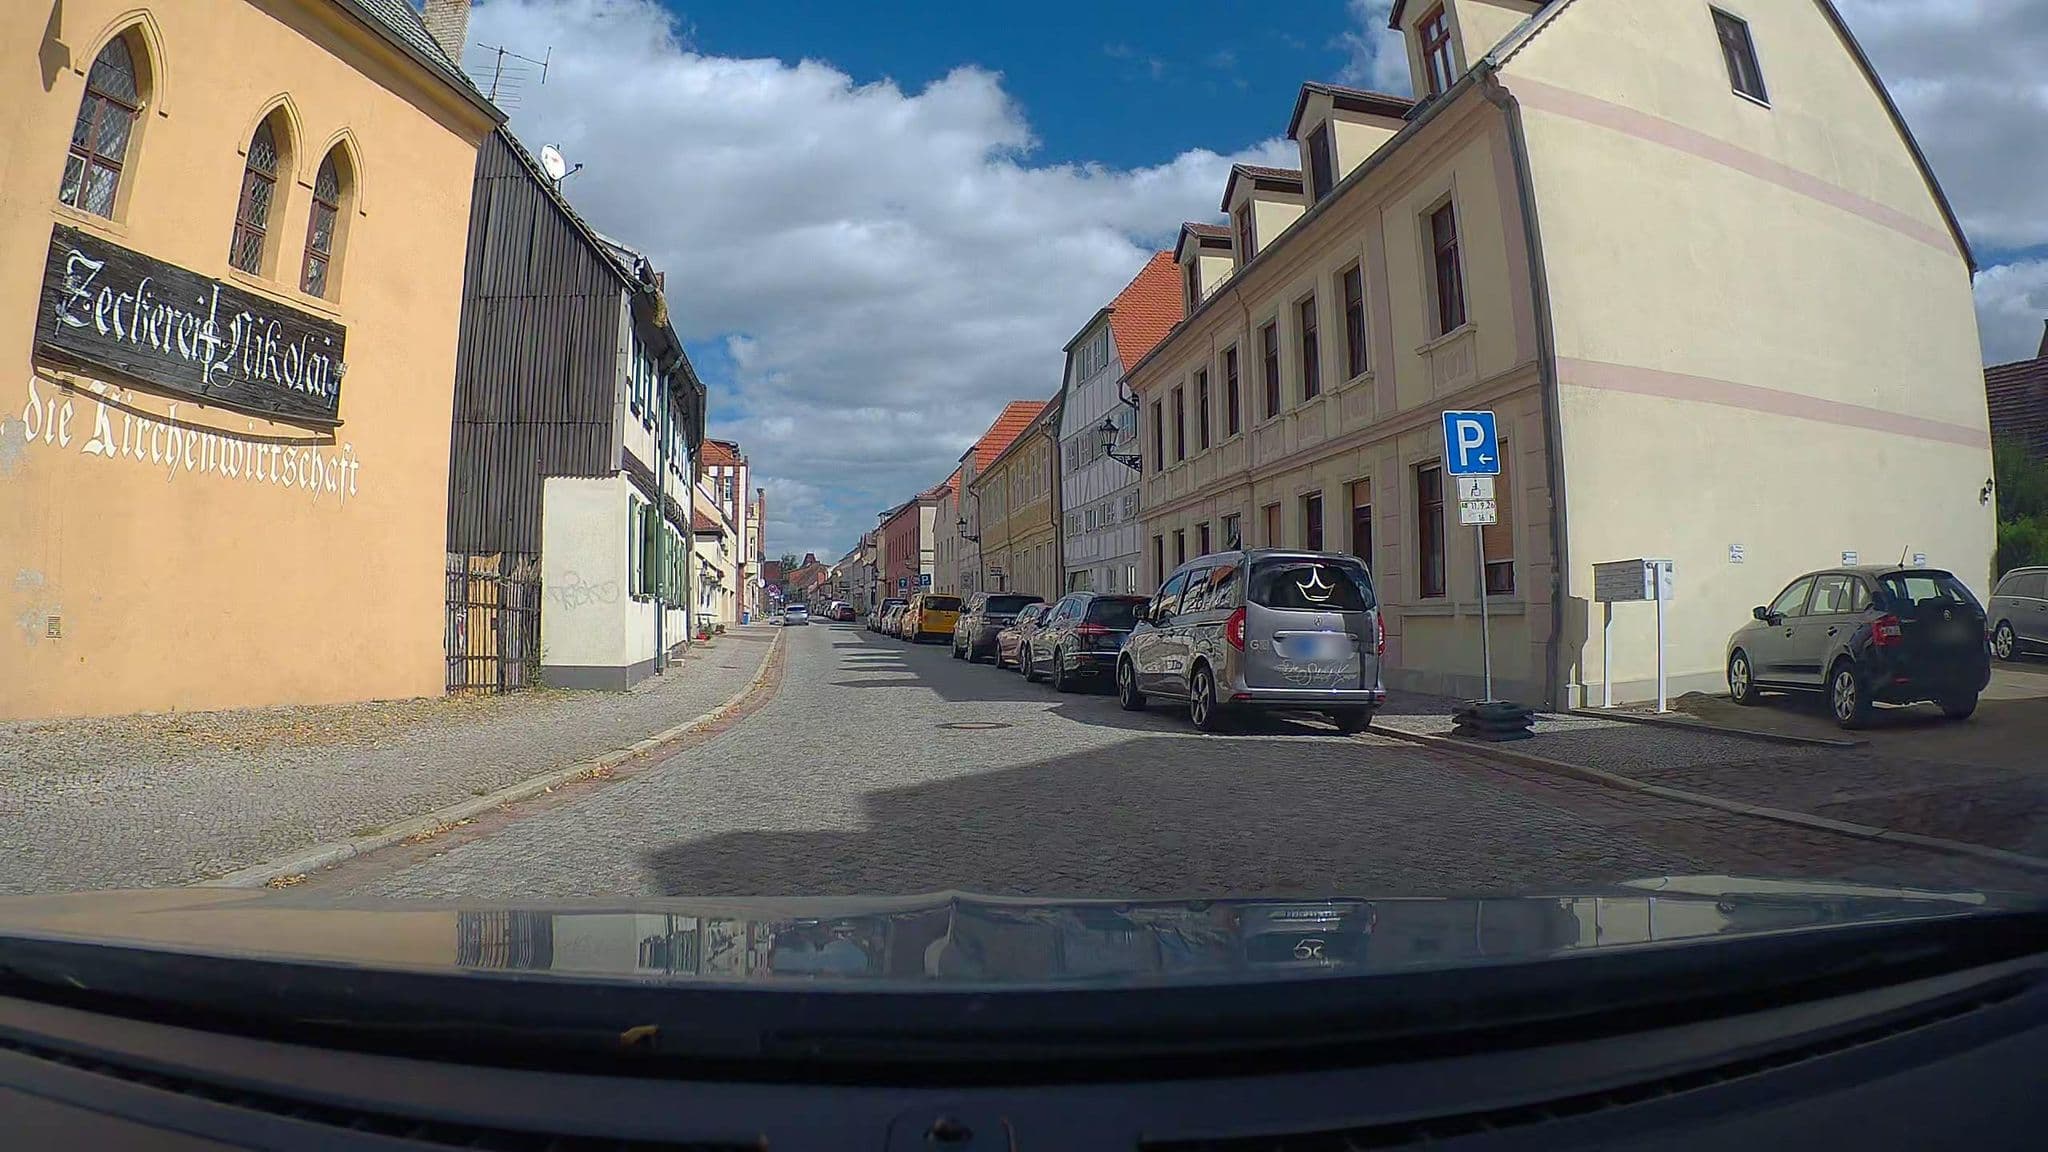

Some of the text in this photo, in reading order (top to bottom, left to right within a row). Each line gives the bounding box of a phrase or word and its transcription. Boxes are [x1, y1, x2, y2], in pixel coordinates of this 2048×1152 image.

[210, 311, 329, 397] Nikolai
[22, 376, 359, 504] die Kirchenwirtschaft
[1457, 420, 1485, 466] P
